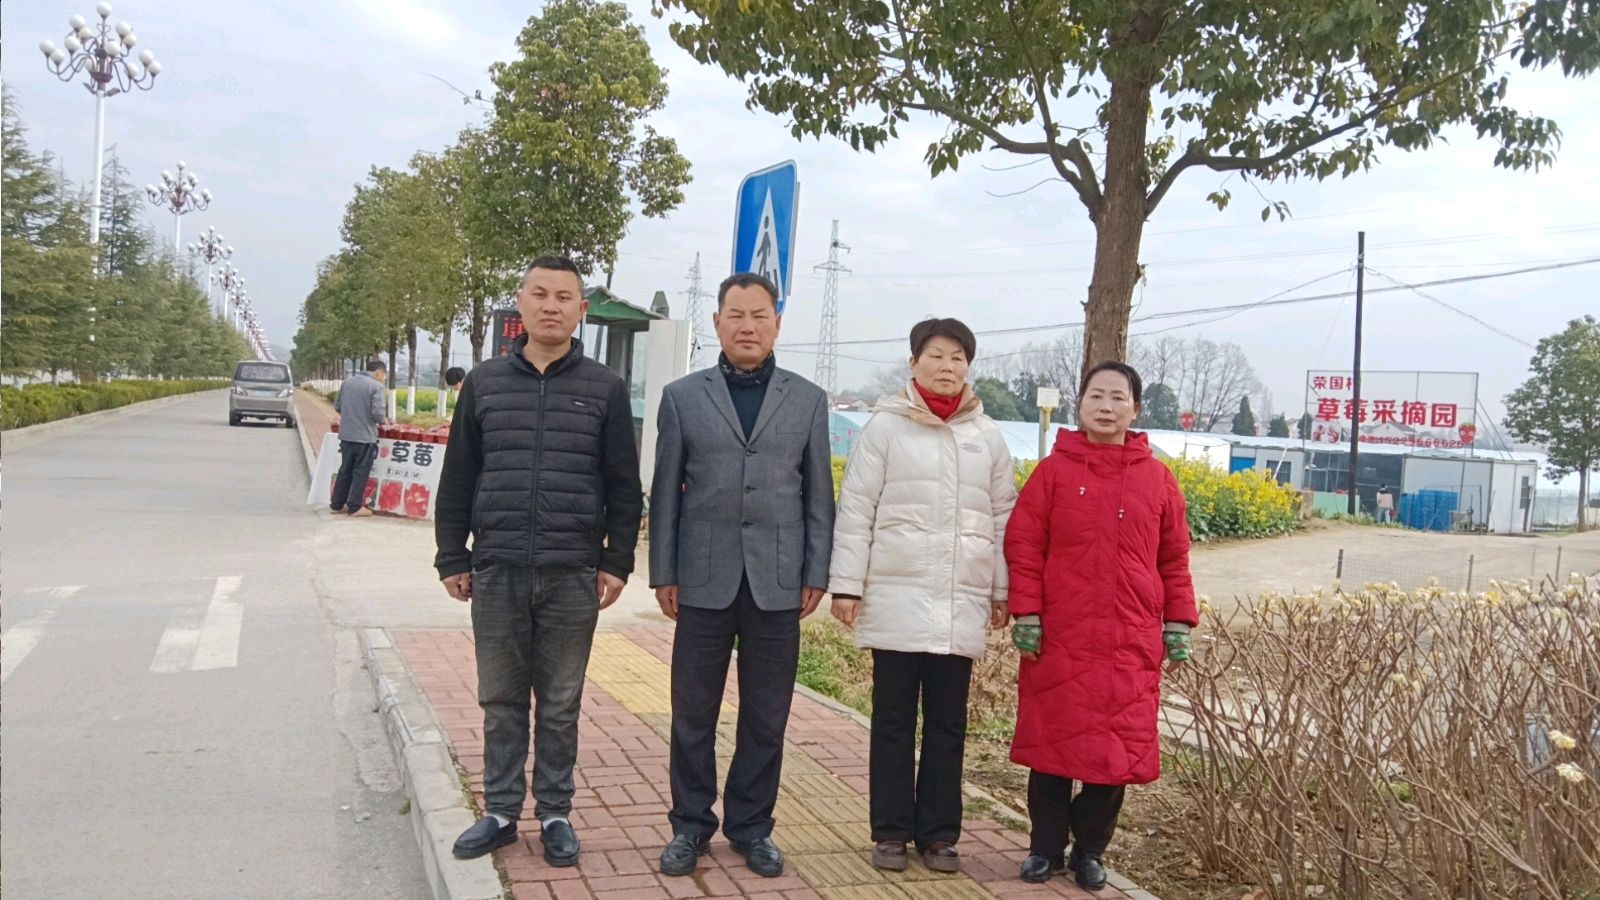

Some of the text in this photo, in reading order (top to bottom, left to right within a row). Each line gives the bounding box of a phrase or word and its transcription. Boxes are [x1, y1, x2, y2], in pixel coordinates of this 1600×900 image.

[1315, 397, 1458, 428] 草莓采摘园
[391, 441, 434, 467] 草莓
